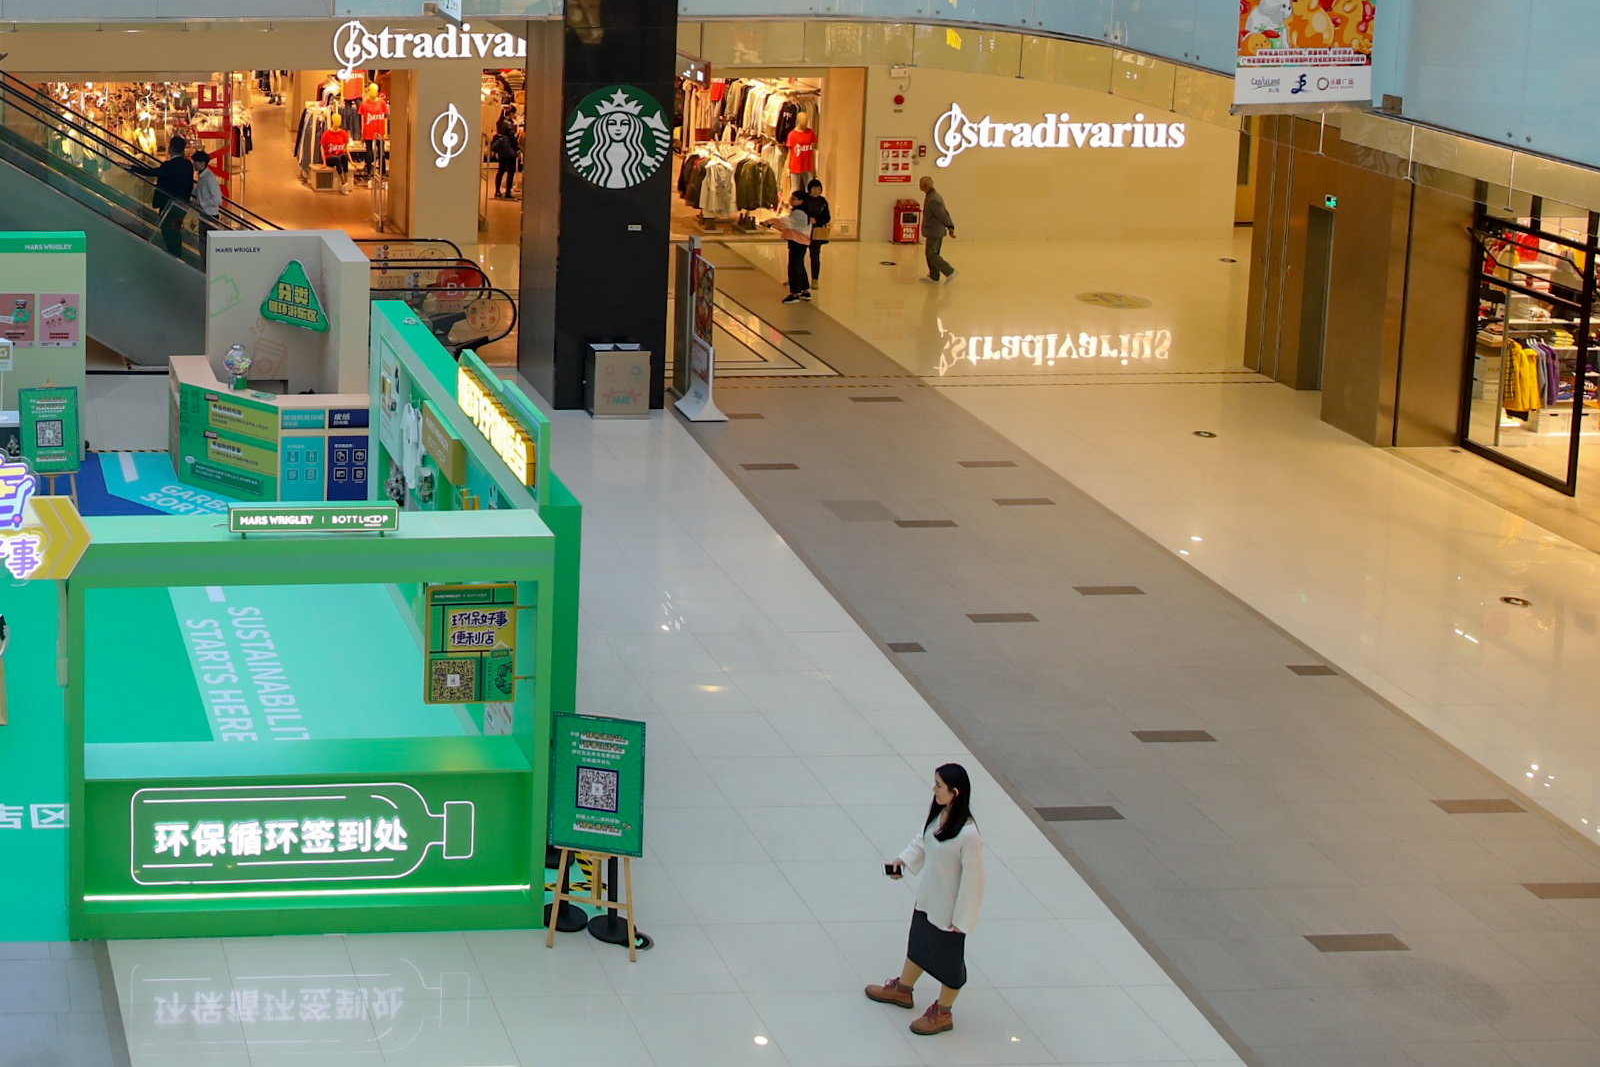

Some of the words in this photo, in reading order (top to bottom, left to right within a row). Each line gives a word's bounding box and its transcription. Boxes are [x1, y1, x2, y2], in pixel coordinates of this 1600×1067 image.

[962, 111, 1185, 148] stradivarius
[160, 485, 229, 512] GARB
[240, 516, 269, 525] MARS
[270, 515, 314, 525] WRIGLEY
[450, 610, 509, 628] 环保好事
[185, 619, 239, 684] STARTS
[450, 629, 496, 647] 便利店
[208, 689, 259, 742] HERE
[153, 818, 409, 858] 环保循环签到处
